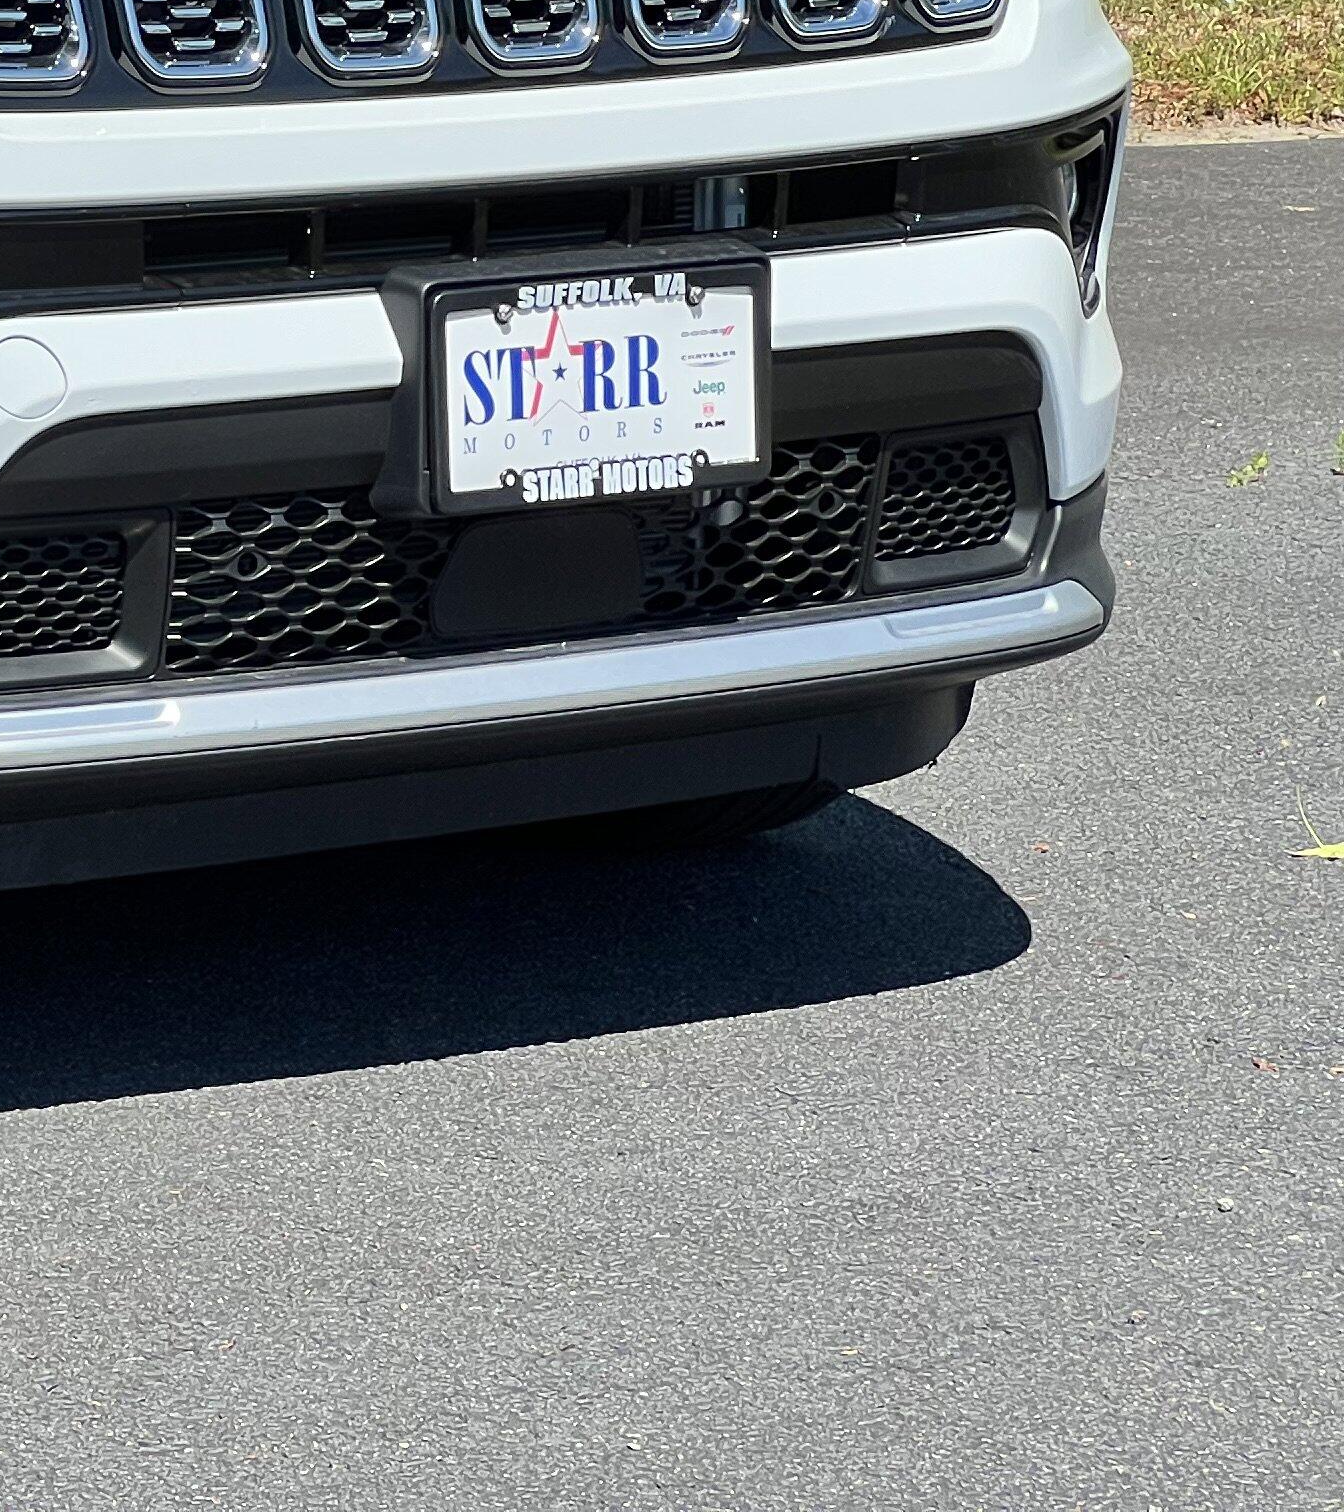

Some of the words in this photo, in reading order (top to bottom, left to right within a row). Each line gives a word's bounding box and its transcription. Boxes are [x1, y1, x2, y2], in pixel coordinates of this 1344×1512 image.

[517, 276, 643, 309] SUFFOLK,
[653, 272, 686, 297] VA
[693, 380, 726, 395] Jeep
[694, 420, 726, 429] RAM
[522, 464, 595, 503] STARR
[602, 454, 694, 495] MOTORS
